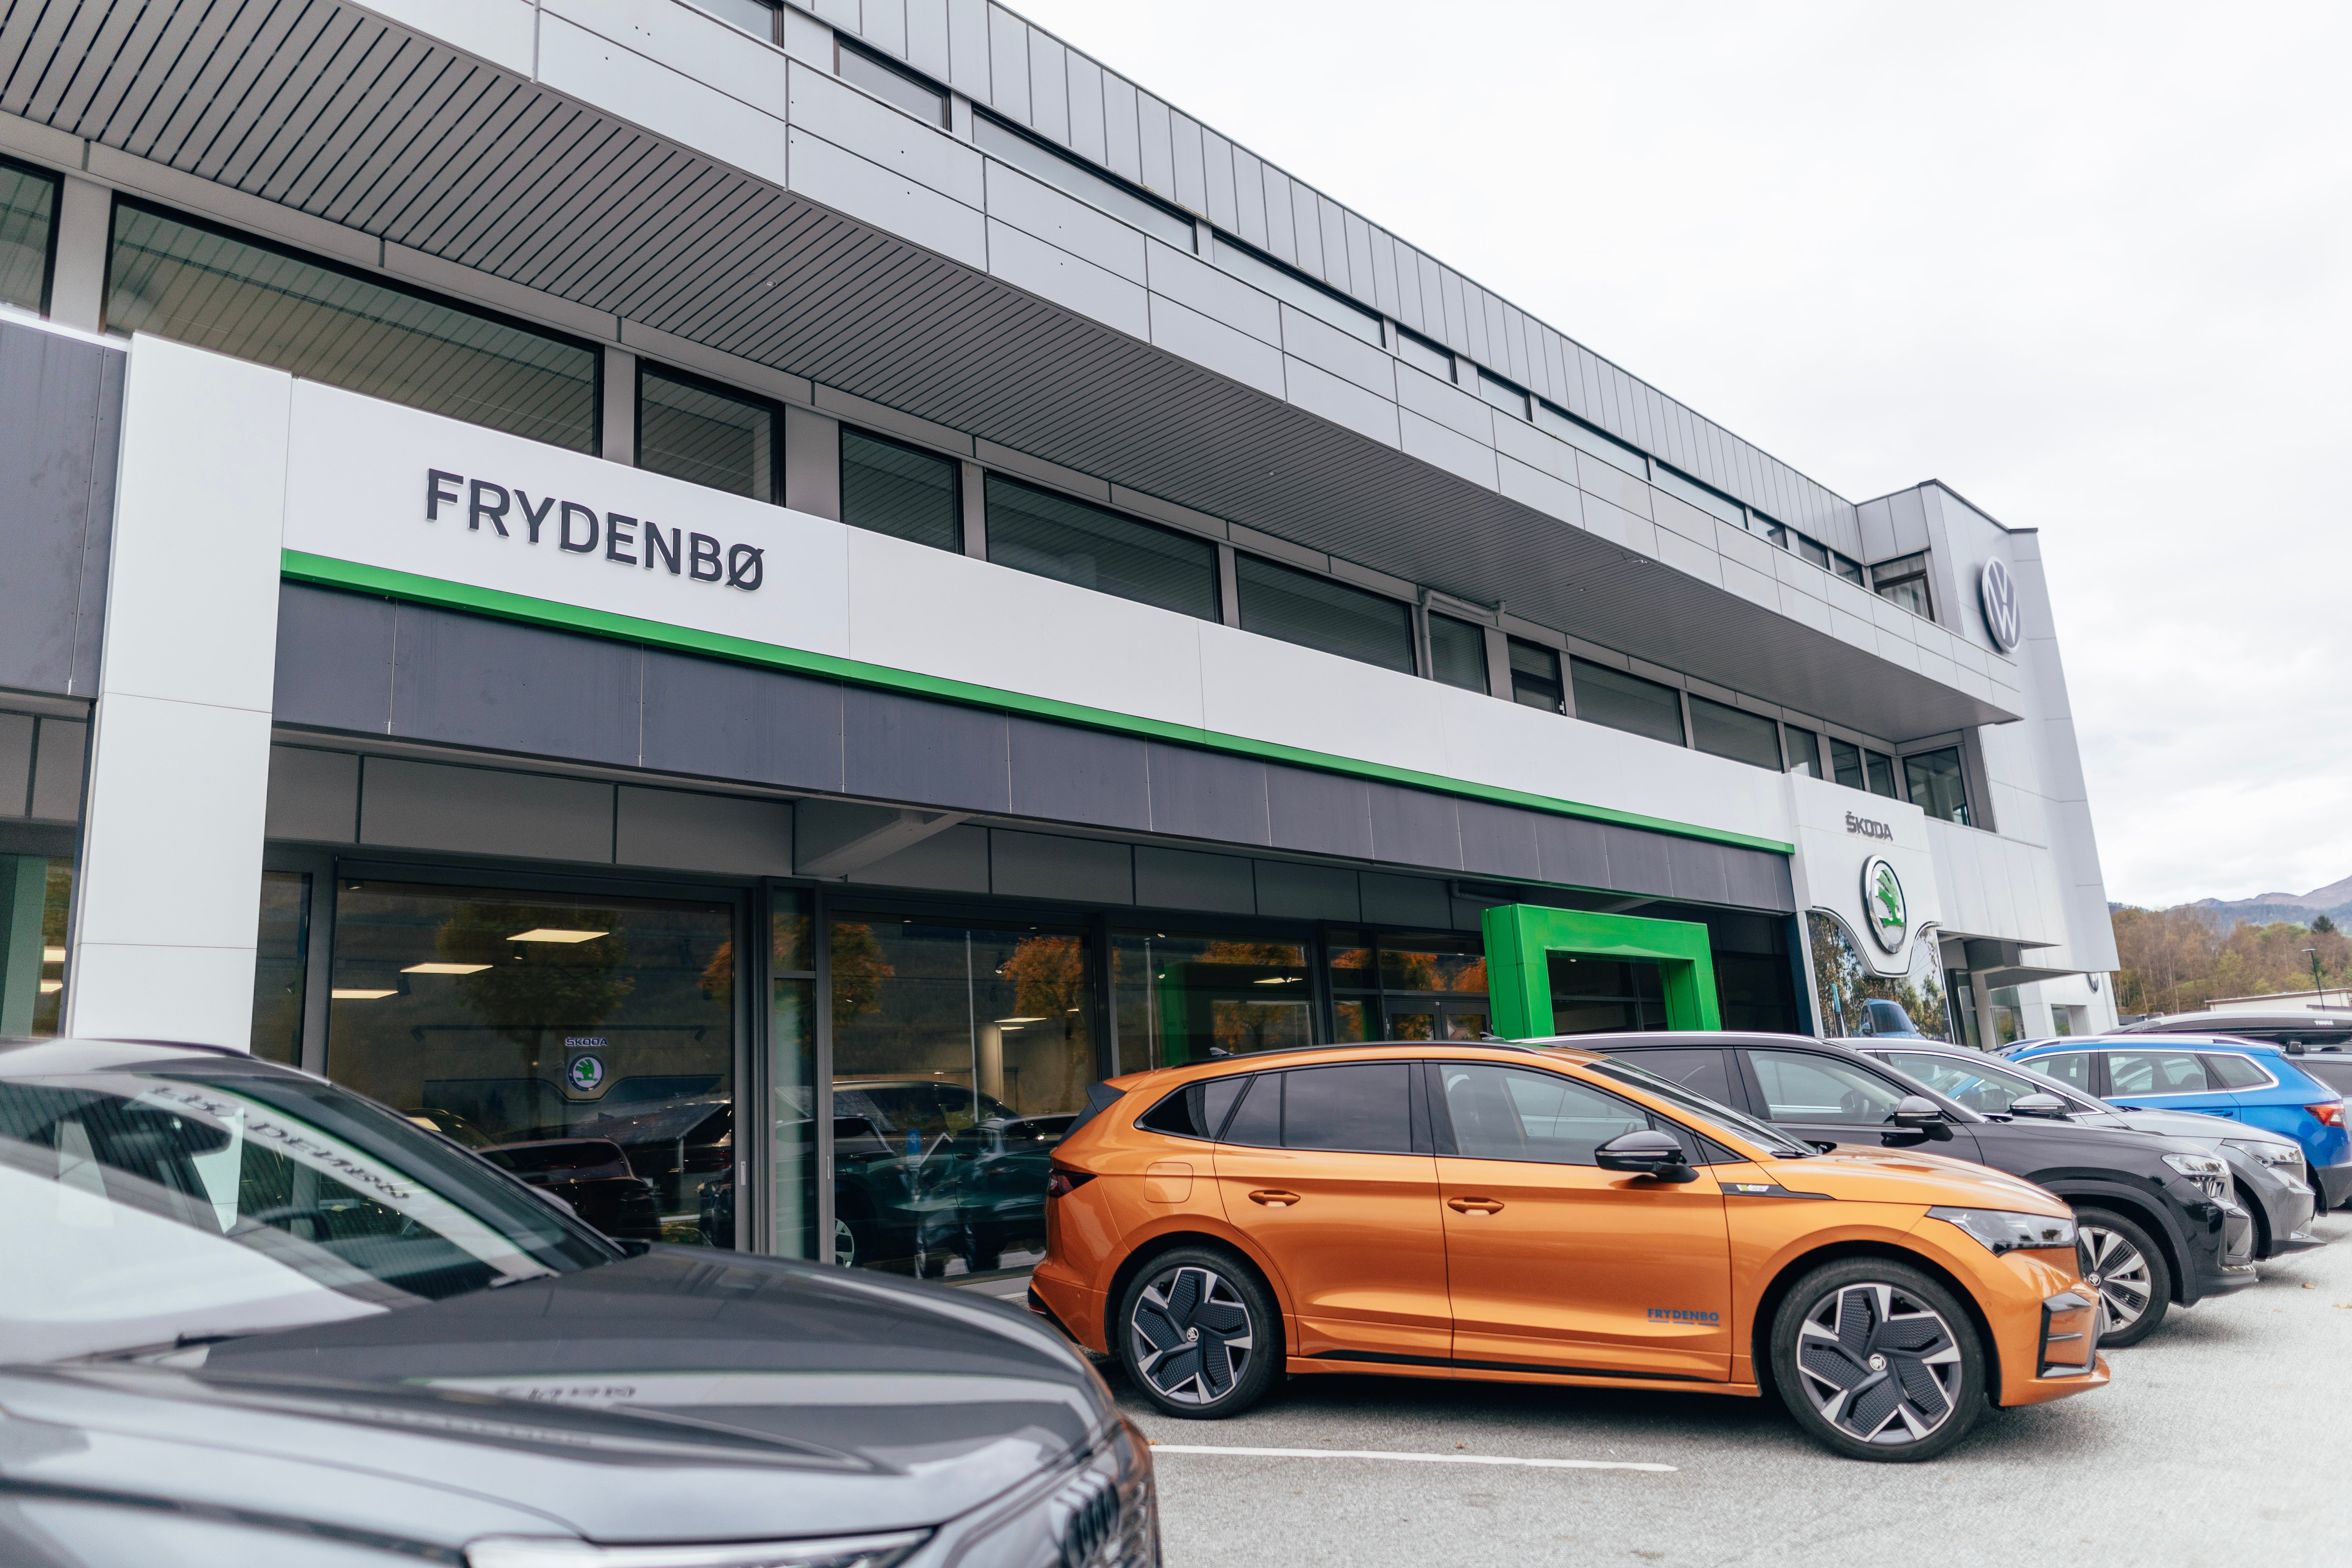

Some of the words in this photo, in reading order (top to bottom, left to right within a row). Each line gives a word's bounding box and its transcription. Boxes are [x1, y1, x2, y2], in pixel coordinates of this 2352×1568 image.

[426, 468, 765, 591] FRYDENBØ
[1845, 811, 1893, 842] ŠKODA
[566, 1037, 608, 1046] ŠKODA
